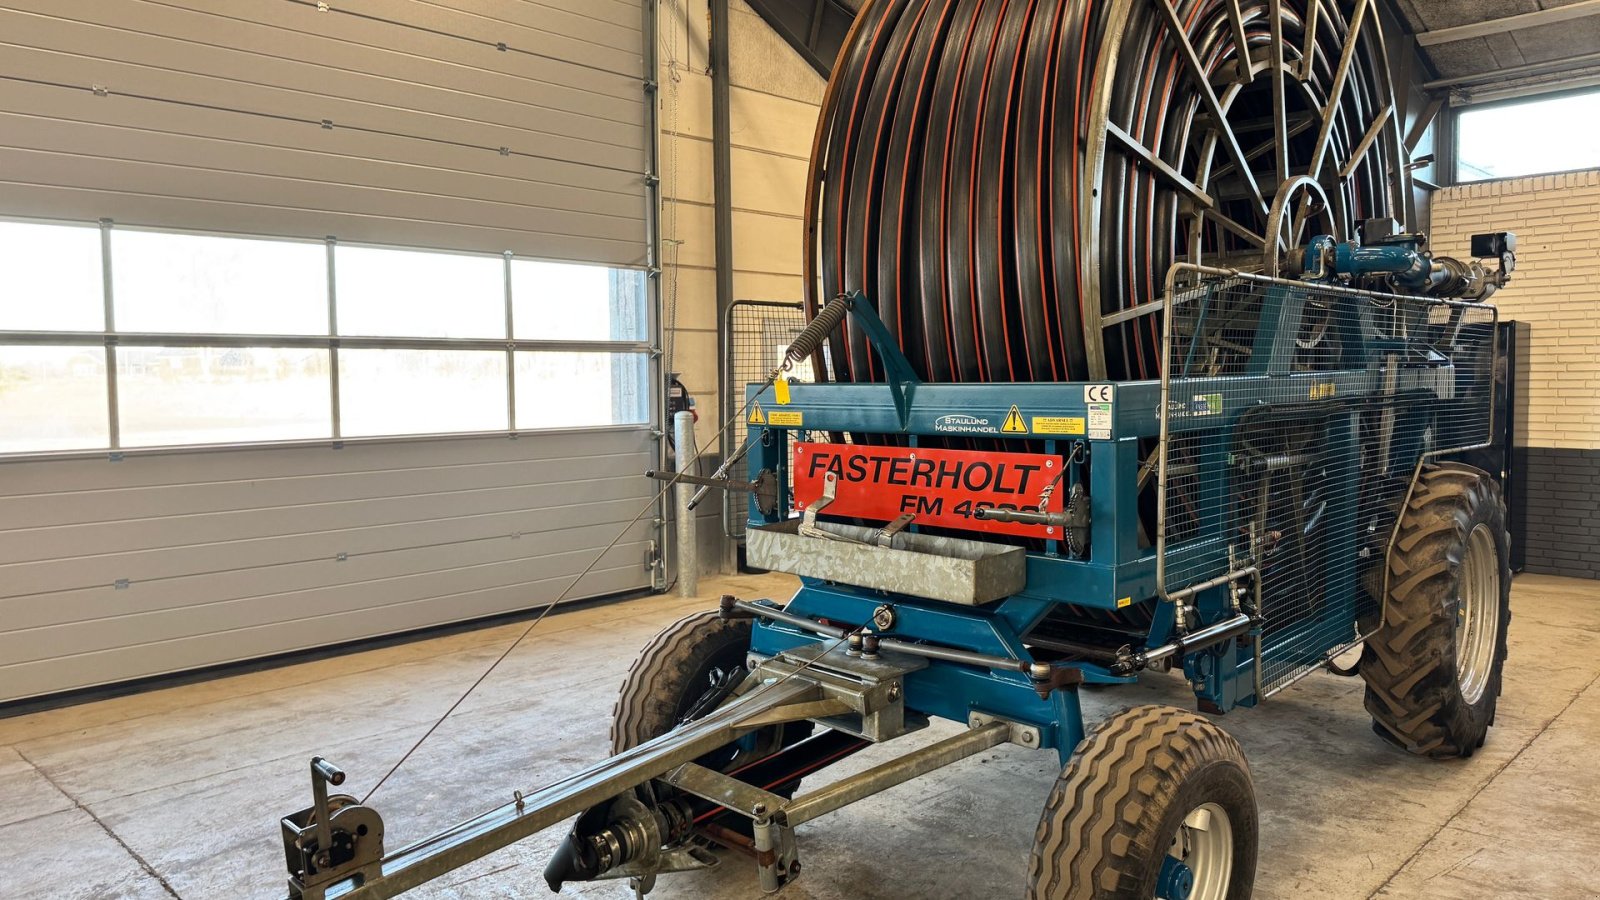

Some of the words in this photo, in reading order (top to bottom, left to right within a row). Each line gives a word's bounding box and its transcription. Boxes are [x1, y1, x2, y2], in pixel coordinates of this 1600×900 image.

[1088, 386, 1109, 402] CE
[944, 416, 989, 425] STAULUND
[935, 424, 1000, 434] MASKINHANDEL
[808, 453, 1041, 495] FASTERHOLT
[900, 494, 943, 516] FM
